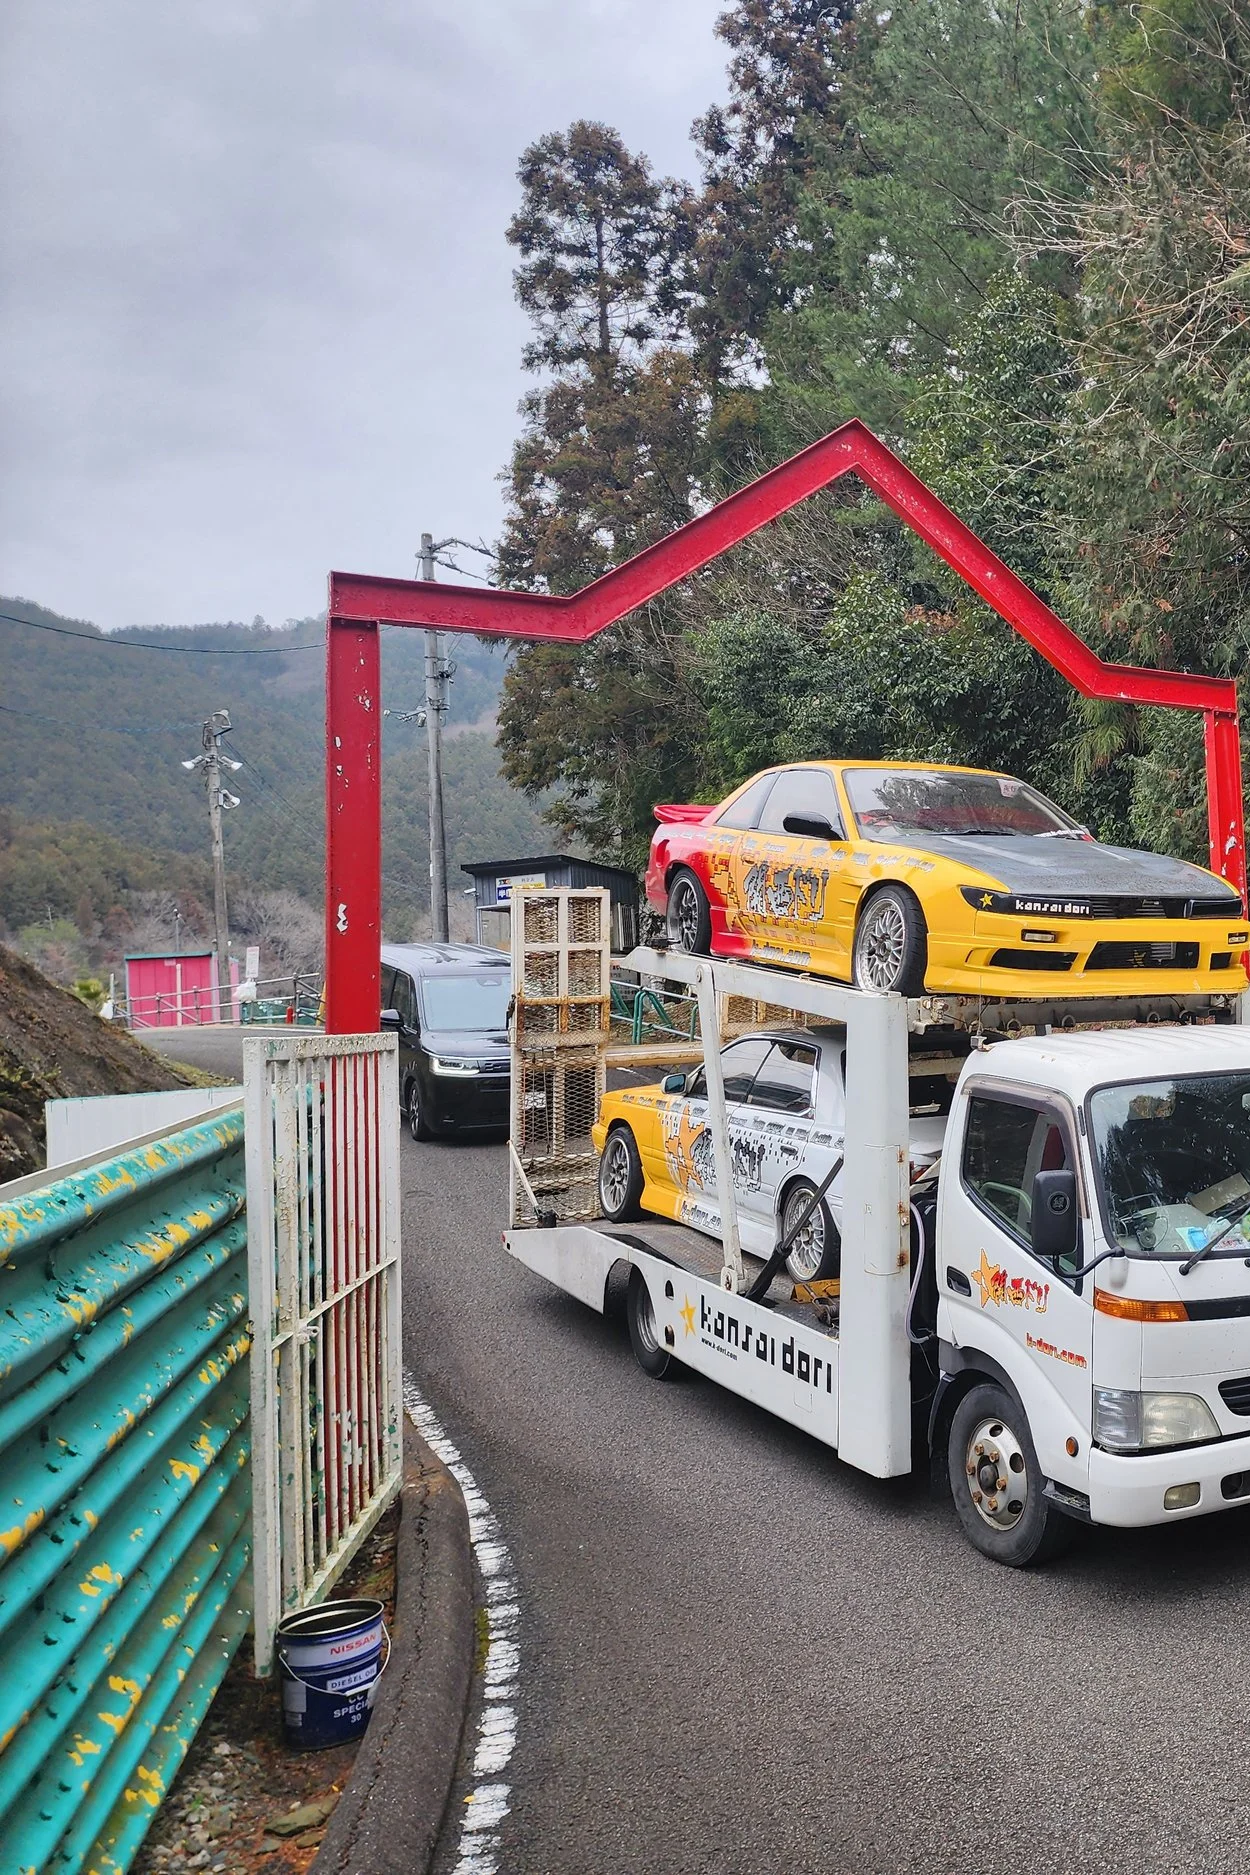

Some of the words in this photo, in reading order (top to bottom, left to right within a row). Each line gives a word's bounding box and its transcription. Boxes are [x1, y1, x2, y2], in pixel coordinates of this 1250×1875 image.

[782, 1336, 832, 1394] dori
[330, 1634, 376, 1655] NISSAN
[331, 1673, 363, 1689] DIESEL
[365, 1667, 376, 1678] OIL
[333, 1699, 369, 1718] SPECIA
[351, 1712, 362, 1723] 30
